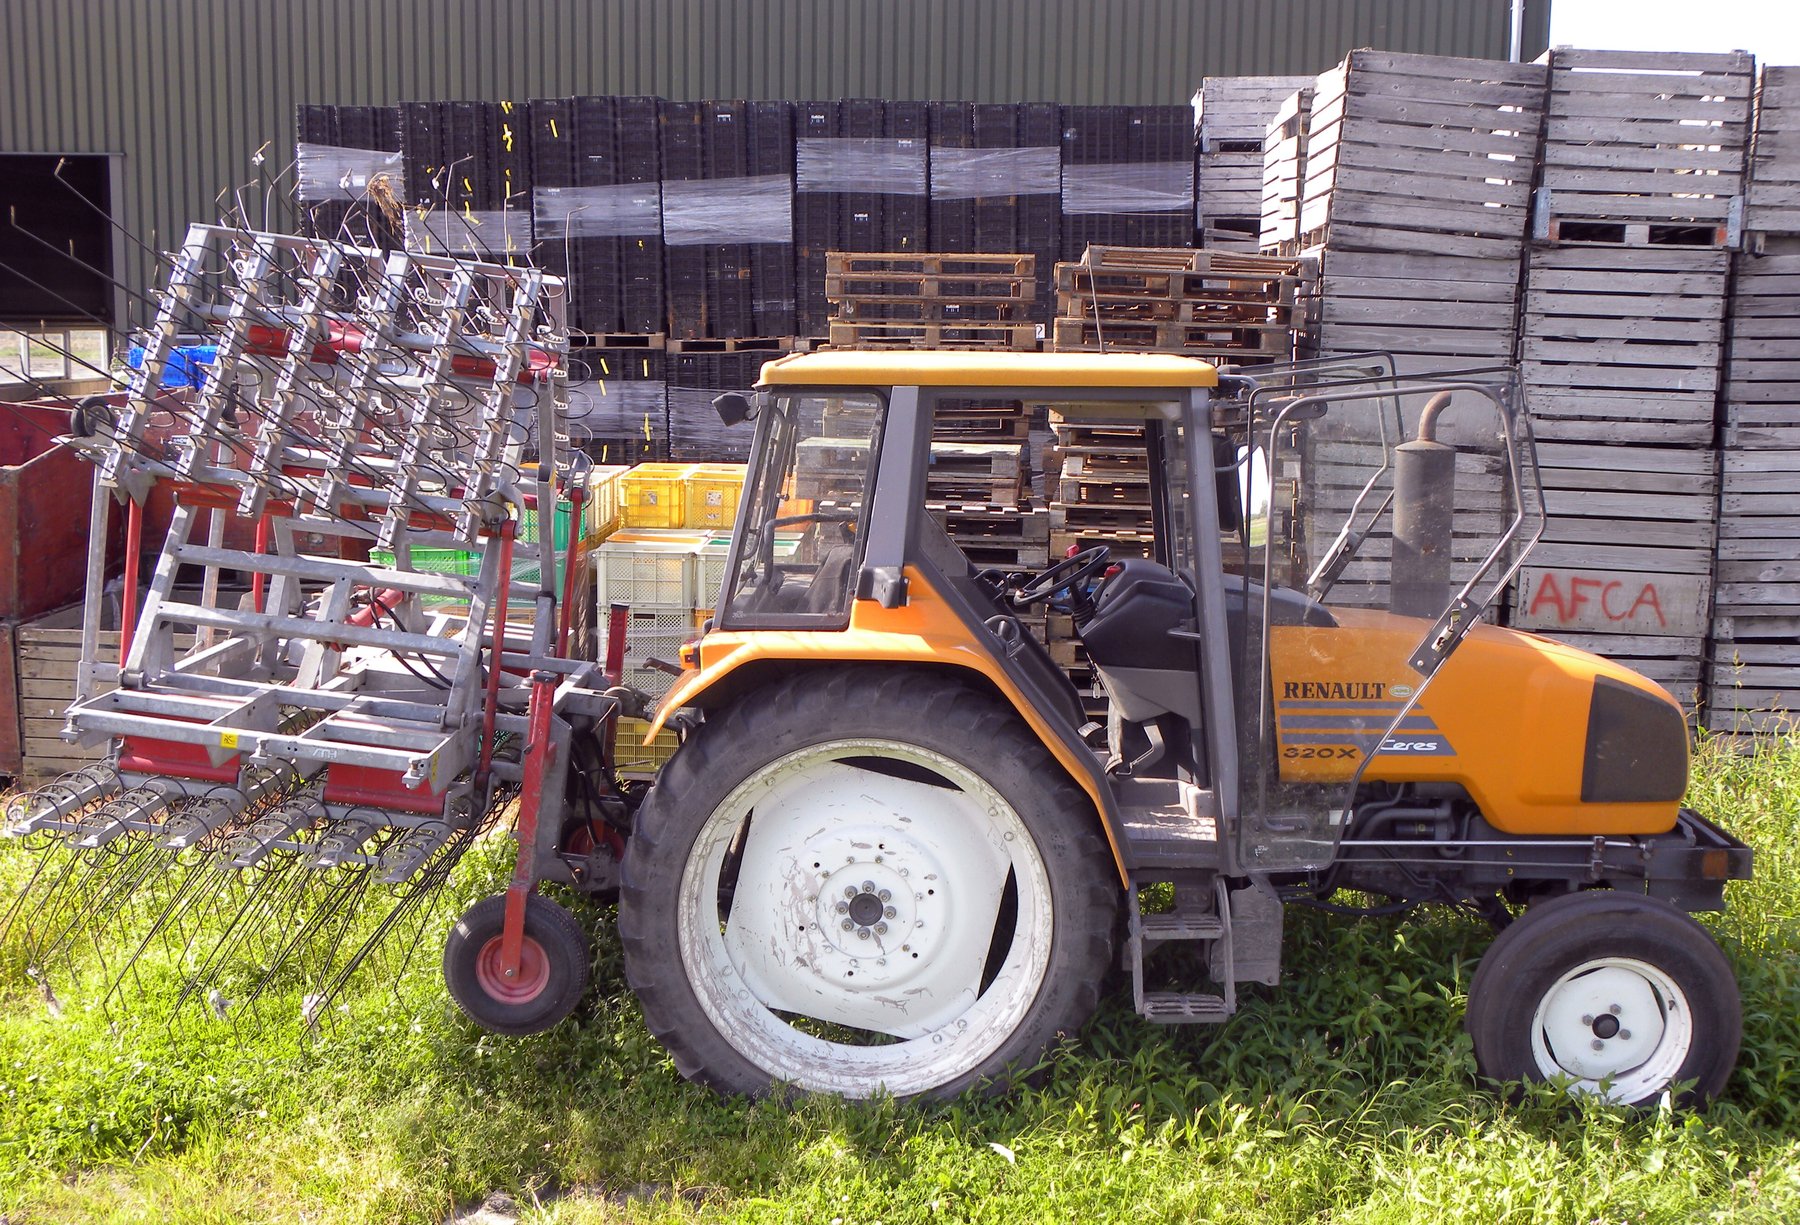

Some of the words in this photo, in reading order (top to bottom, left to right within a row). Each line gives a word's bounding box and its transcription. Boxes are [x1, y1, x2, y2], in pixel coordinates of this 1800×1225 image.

[1529, 572, 1667, 627] AFCA
[1283, 682, 1386, 699] RENAULT
[1379, 739, 1438, 751] Ceres
[1283, 747, 1357, 759] 320X
